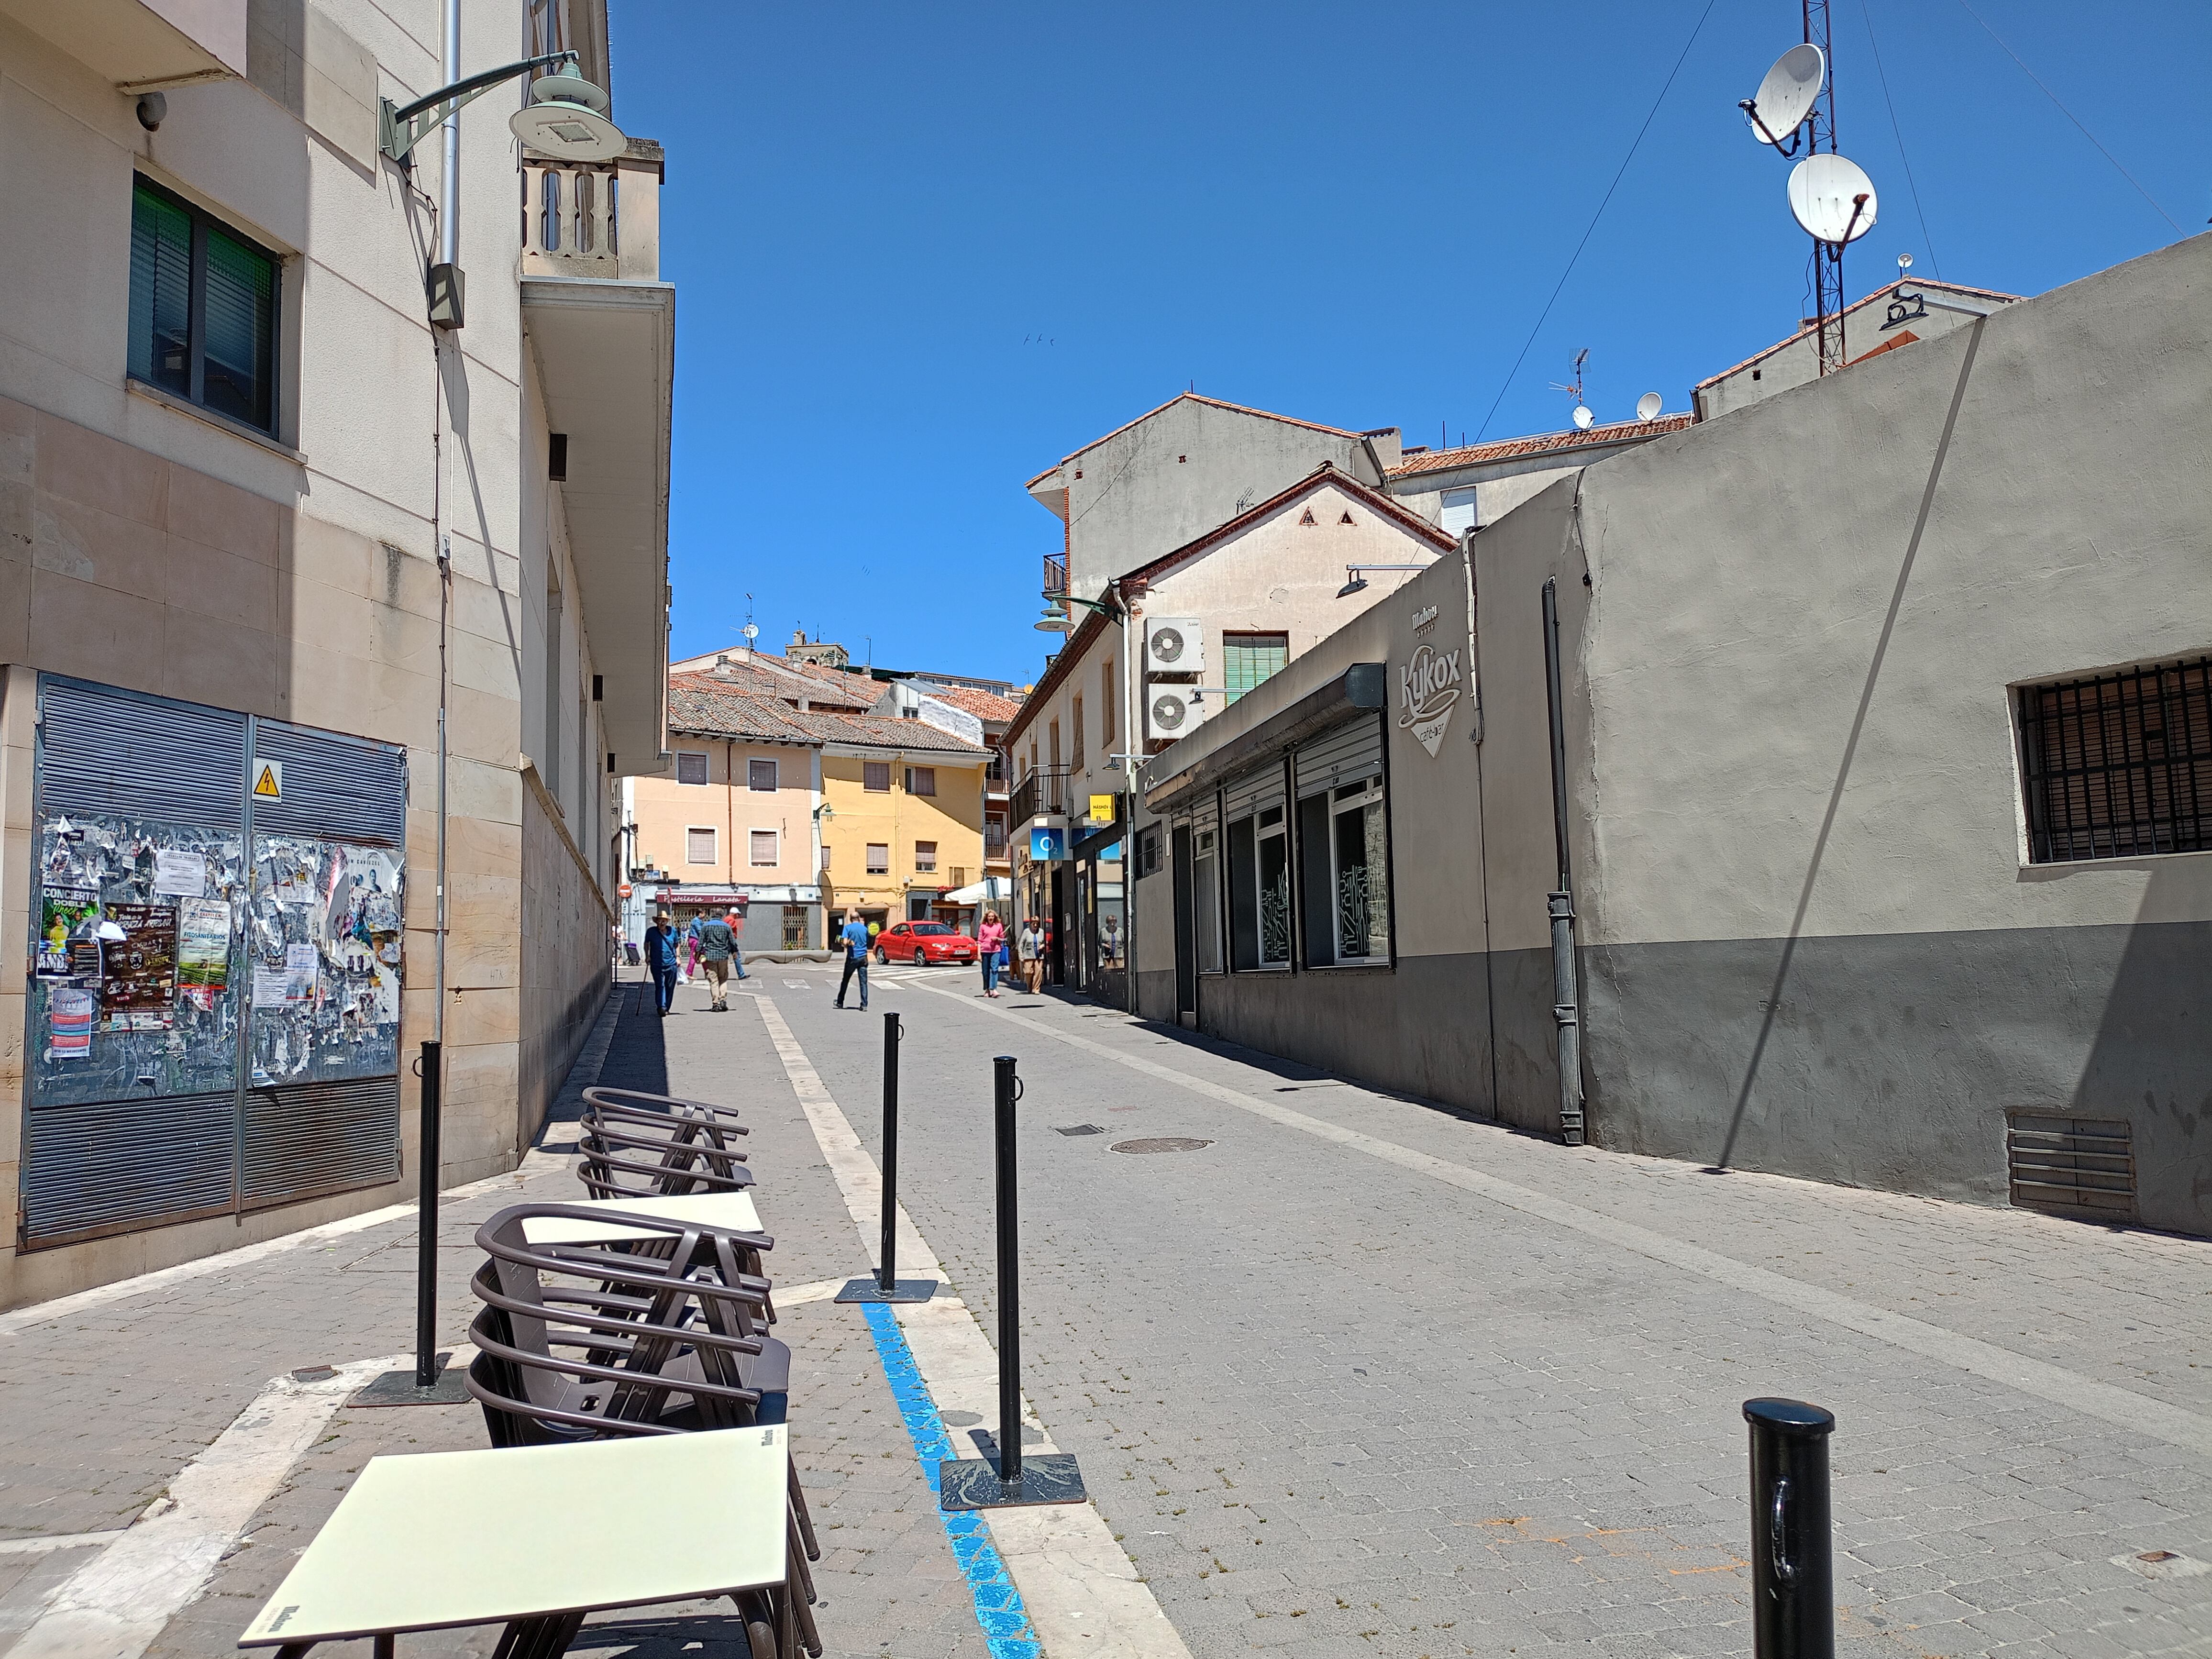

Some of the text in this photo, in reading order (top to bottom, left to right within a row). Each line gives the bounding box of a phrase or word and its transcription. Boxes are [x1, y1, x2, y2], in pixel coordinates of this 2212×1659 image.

[1412, 605, 1438, 630] Mahou
[1398, 645, 1462, 720] Kykox
[1419, 722, 1445, 743] café-bar
[1040, 836, 1058, 854] O2
[43, 887, 97, 902] CONCIERTO
[53, 899, 87, 908] DOBLE
[184, 931, 226, 940] FITOSANITARIOS
